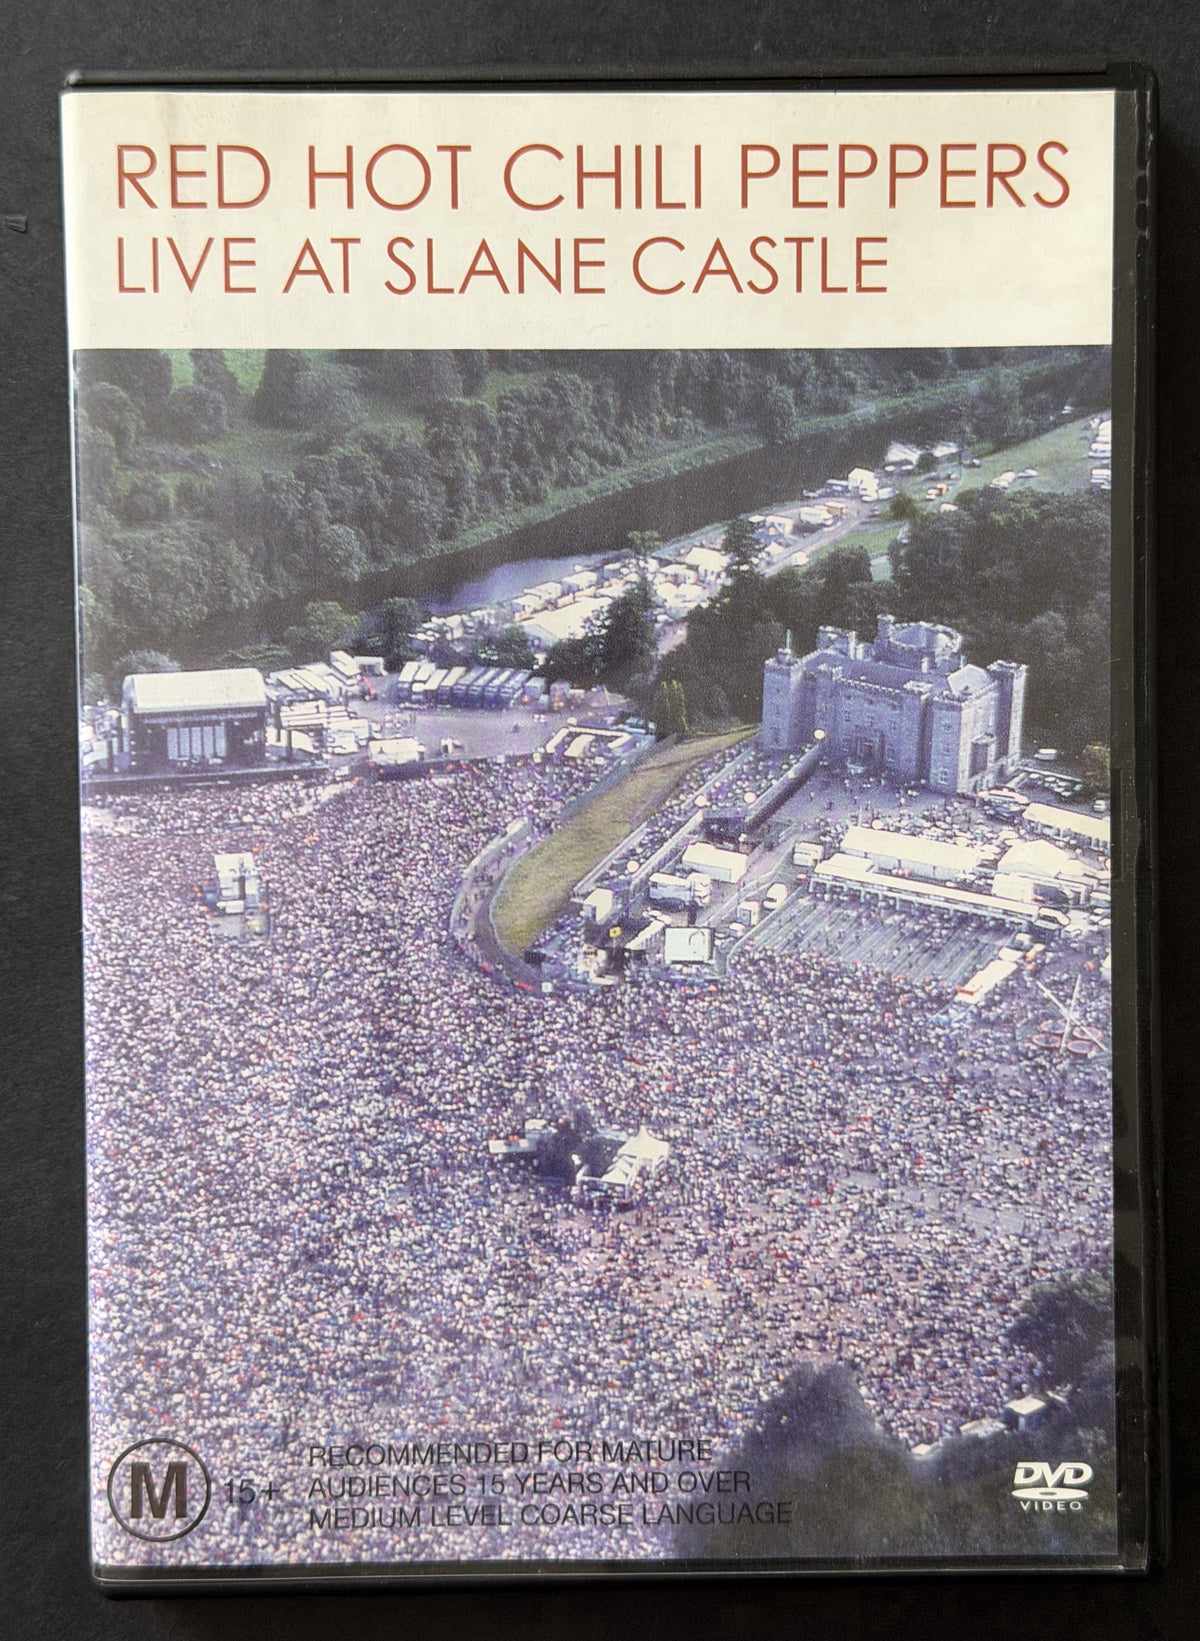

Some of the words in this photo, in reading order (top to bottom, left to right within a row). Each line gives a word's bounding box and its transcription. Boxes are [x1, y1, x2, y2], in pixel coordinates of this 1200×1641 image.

[117, 144, 271, 211] RED
[308, 143, 472, 211] HOT
[503, 143, 702, 211] CHILI
[741, 140, 1071, 209] PEPPERS
[117, 236, 257, 293] LIVE
[282, 237, 361, 294] AT
[384, 236, 606, 295] SLANE
[632, 235, 888, 295] CASTLE
[309, 1442, 529, 1467] RECOMMENDED
[537, 1440, 593, 1463] FOR
[602, 1439, 713, 1462] MATURE
[308, 1474, 466, 1499] AUDIENCES
[480, 1474, 504, 1495] 15
[514, 1472, 602, 1494] YEARS
[611, 1472, 669, 1494] AND
[677, 1471, 751, 1493] OVER
[1013, 1462, 1093, 1488] DVD
[130, 1461, 188, 1519] M
[223, 1478, 280, 1504] 15+
[309, 1506, 421, 1530] MEDIUM
[430, 1505, 512, 1527] LEVEL
[520, 1503, 634, 1526] COARSE
[642, 1502, 793, 1525] LANGUAGE
[1020, 1501, 1082, 1511] VIDEO
